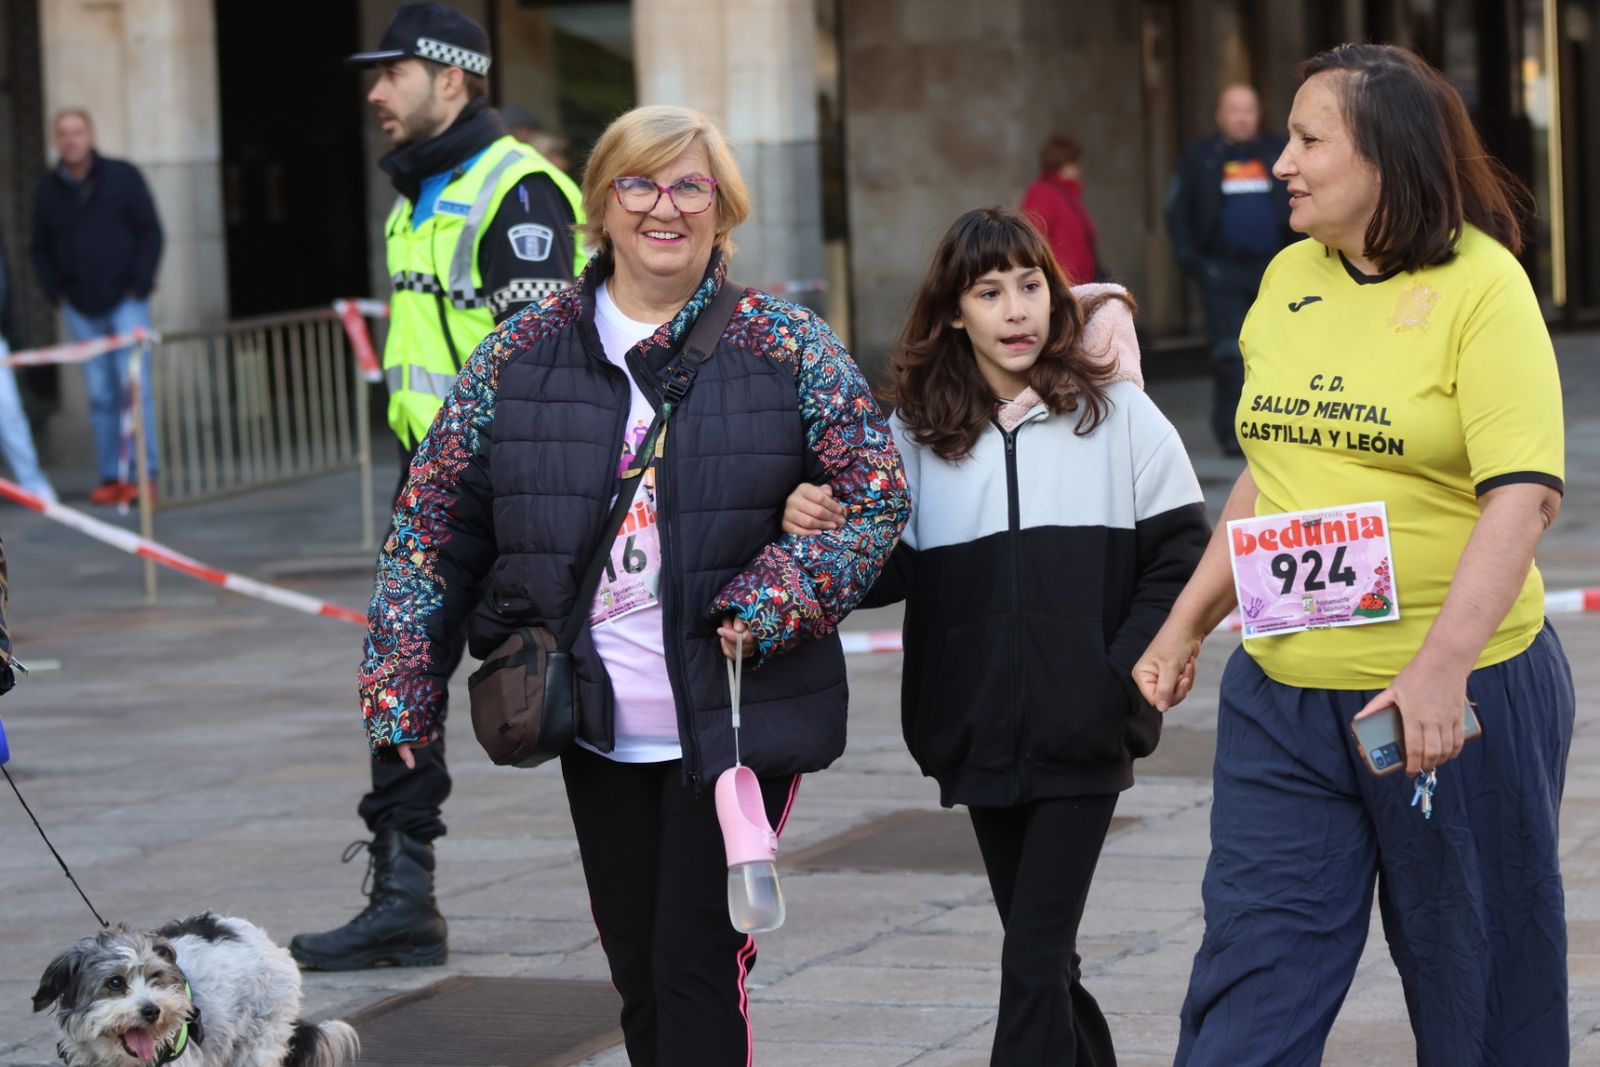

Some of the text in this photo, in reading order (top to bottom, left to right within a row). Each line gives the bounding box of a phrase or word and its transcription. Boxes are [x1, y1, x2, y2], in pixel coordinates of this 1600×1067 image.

[1309, 374, 1345, 392] C. D.
[1250, 394, 1392, 427] SALUD MENTAL
[1240, 421, 1405, 456] CASTILLA Y LEÓN
[1231, 511, 1385, 557] bedunia
[1270, 545, 1357, 595] 924
